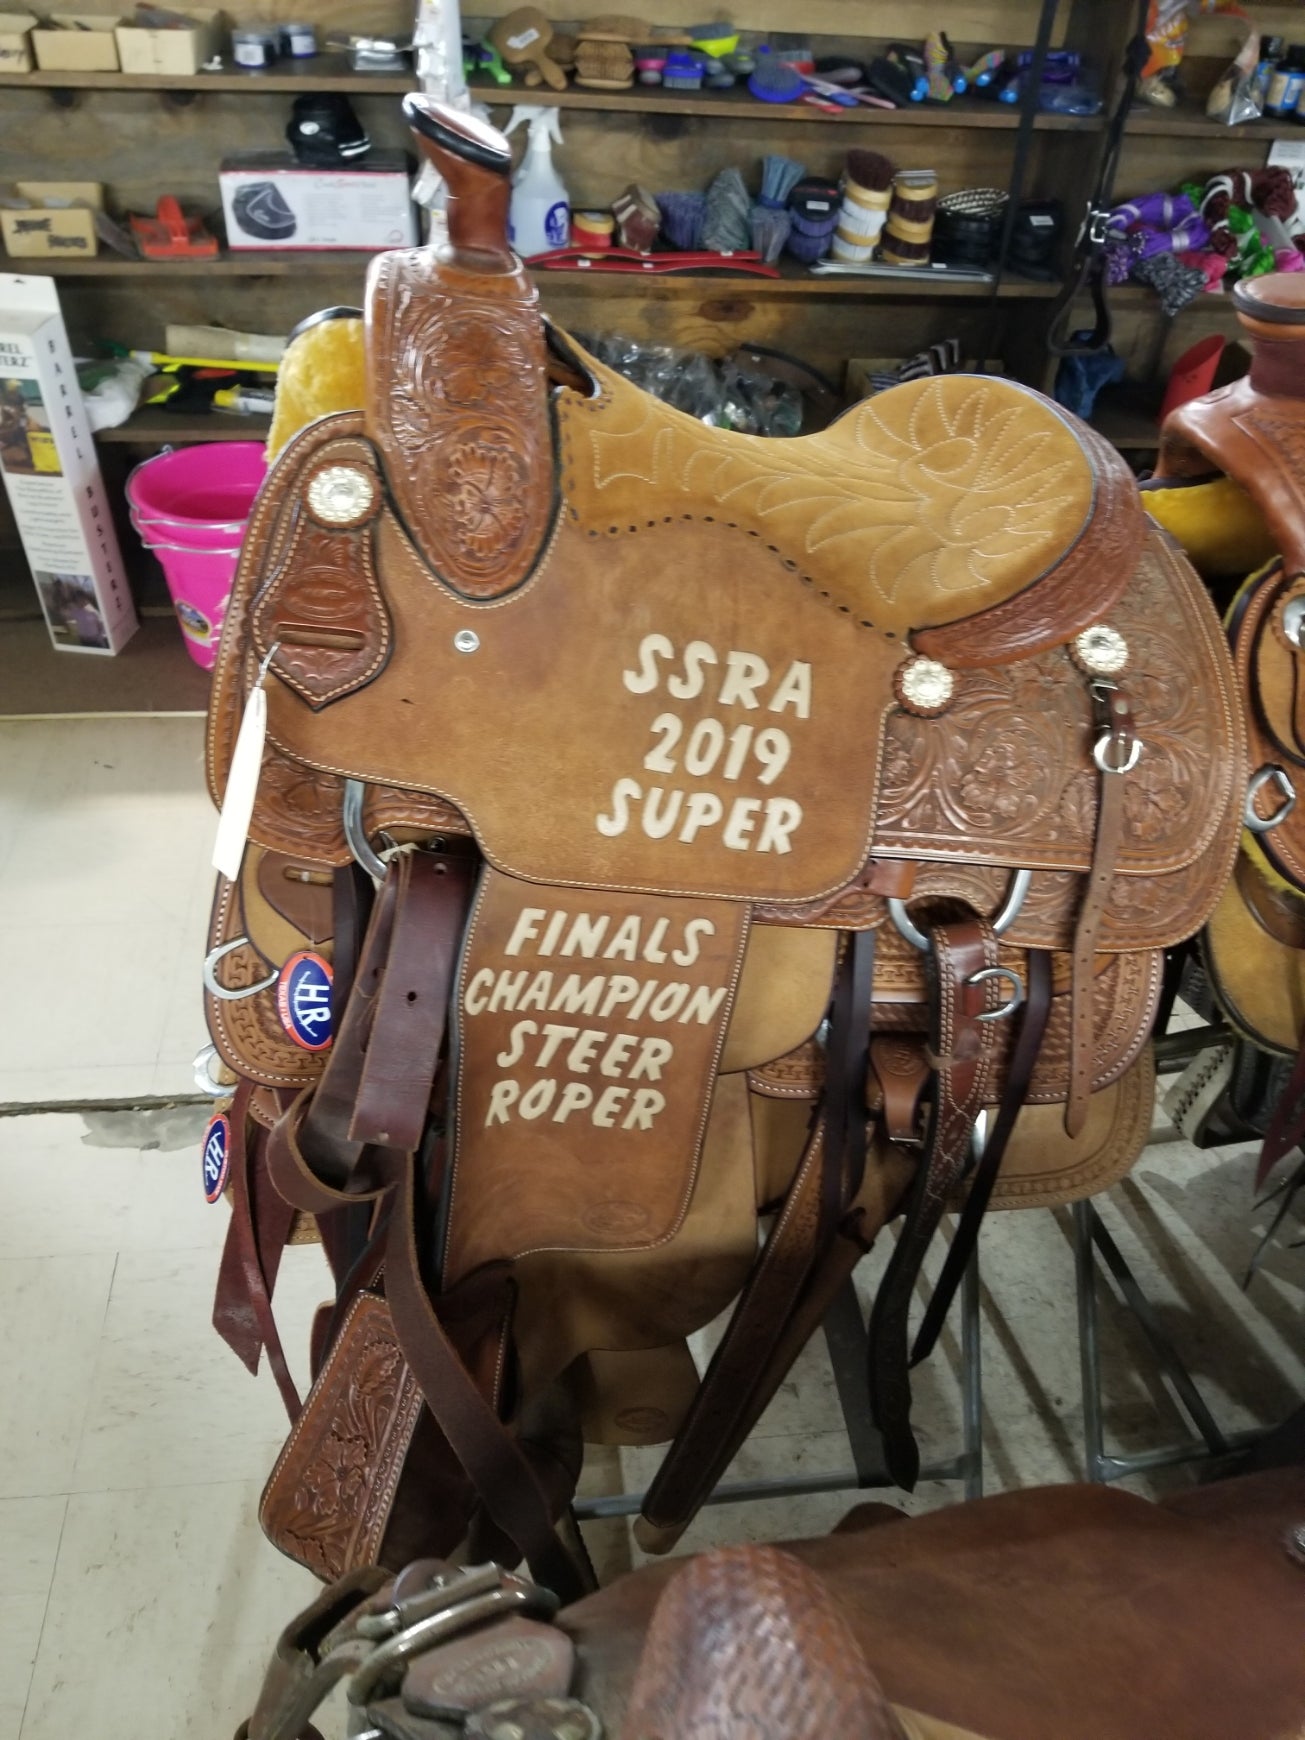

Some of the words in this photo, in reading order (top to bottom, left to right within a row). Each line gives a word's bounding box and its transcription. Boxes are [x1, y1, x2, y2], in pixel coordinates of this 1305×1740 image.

[623, 633, 811, 719] SSRA
[643, 714, 790, 784] 2019
[595, 778, 802, 854] SUPER
[506, 909, 713, 965] FINALS
[296, 984, 332, 1027] HR
[467, 969, 727, 1023] CHAMPION
[497, 1021, 672, 1079] STEER
[488, 1080, 664, 1128] ROPER
[204, 1137, 224, 1181] HR
